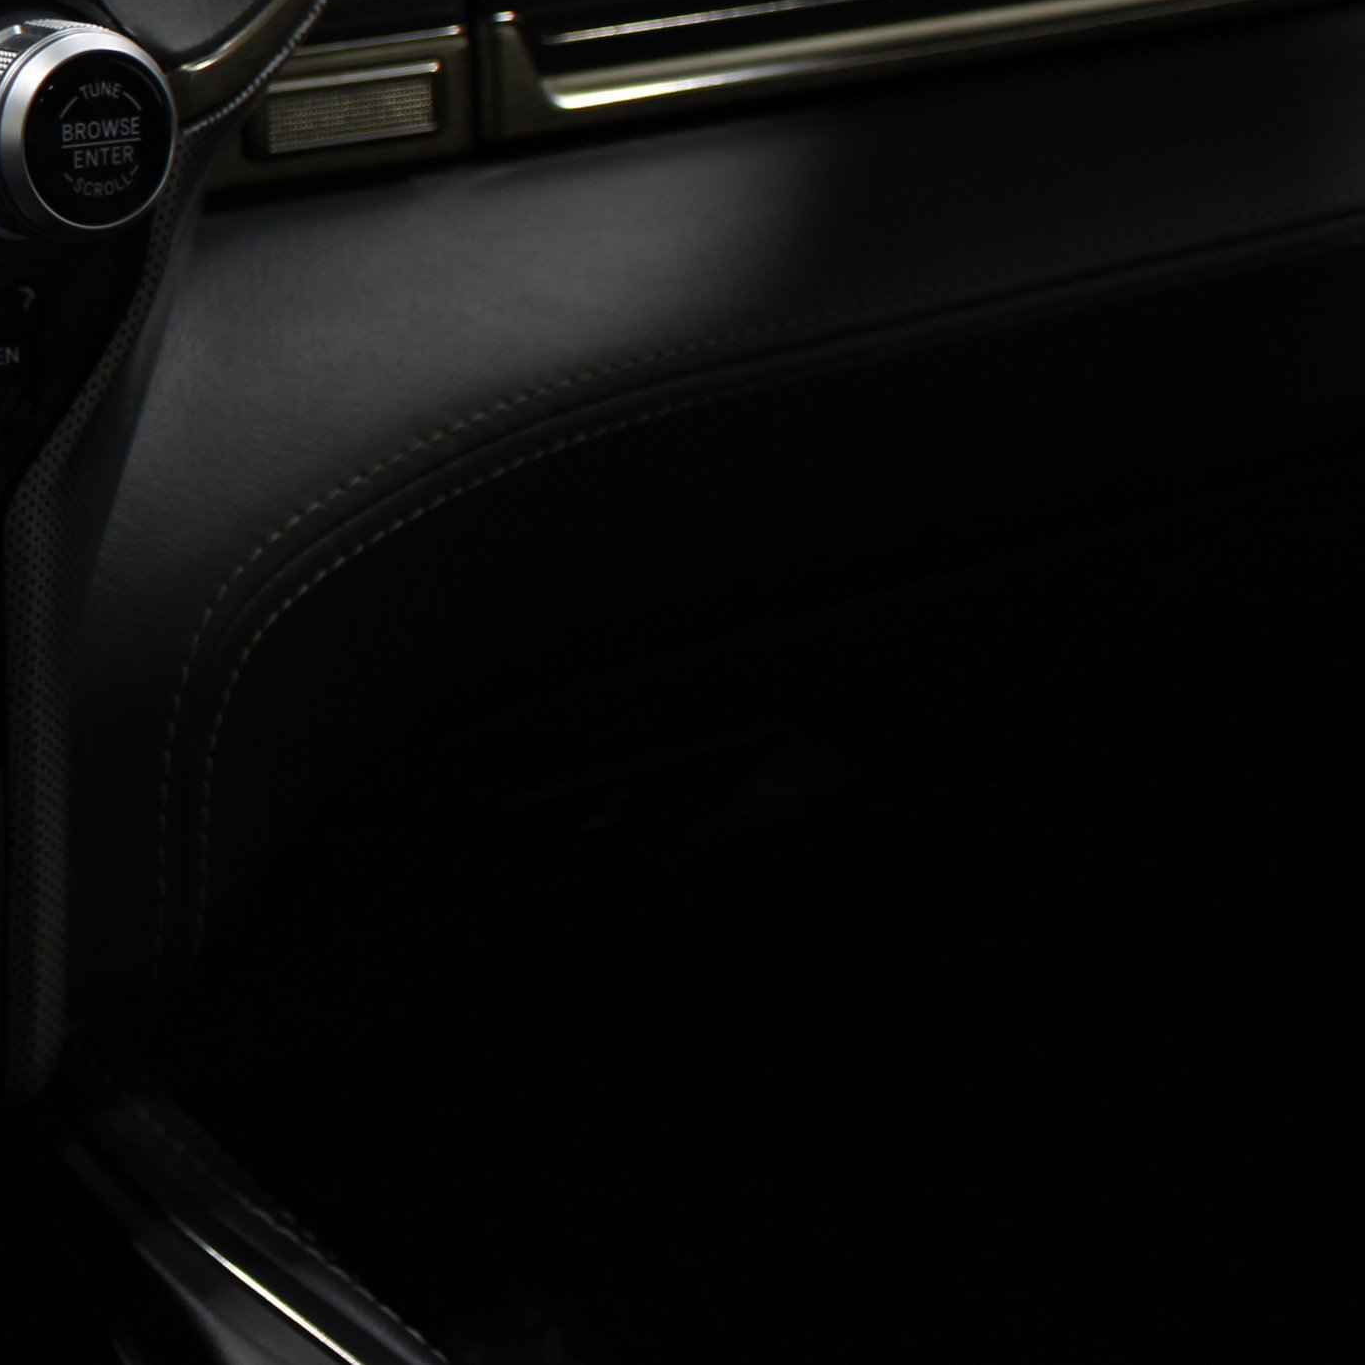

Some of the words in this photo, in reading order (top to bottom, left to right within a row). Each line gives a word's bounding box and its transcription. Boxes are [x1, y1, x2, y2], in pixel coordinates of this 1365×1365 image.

[80, 80, 122, 100] TUNE
[61, 116, 141, 143] BROWSE
[72, 146, 135, 170] ENTER
[72, 174, 133, 198] SCROLL
